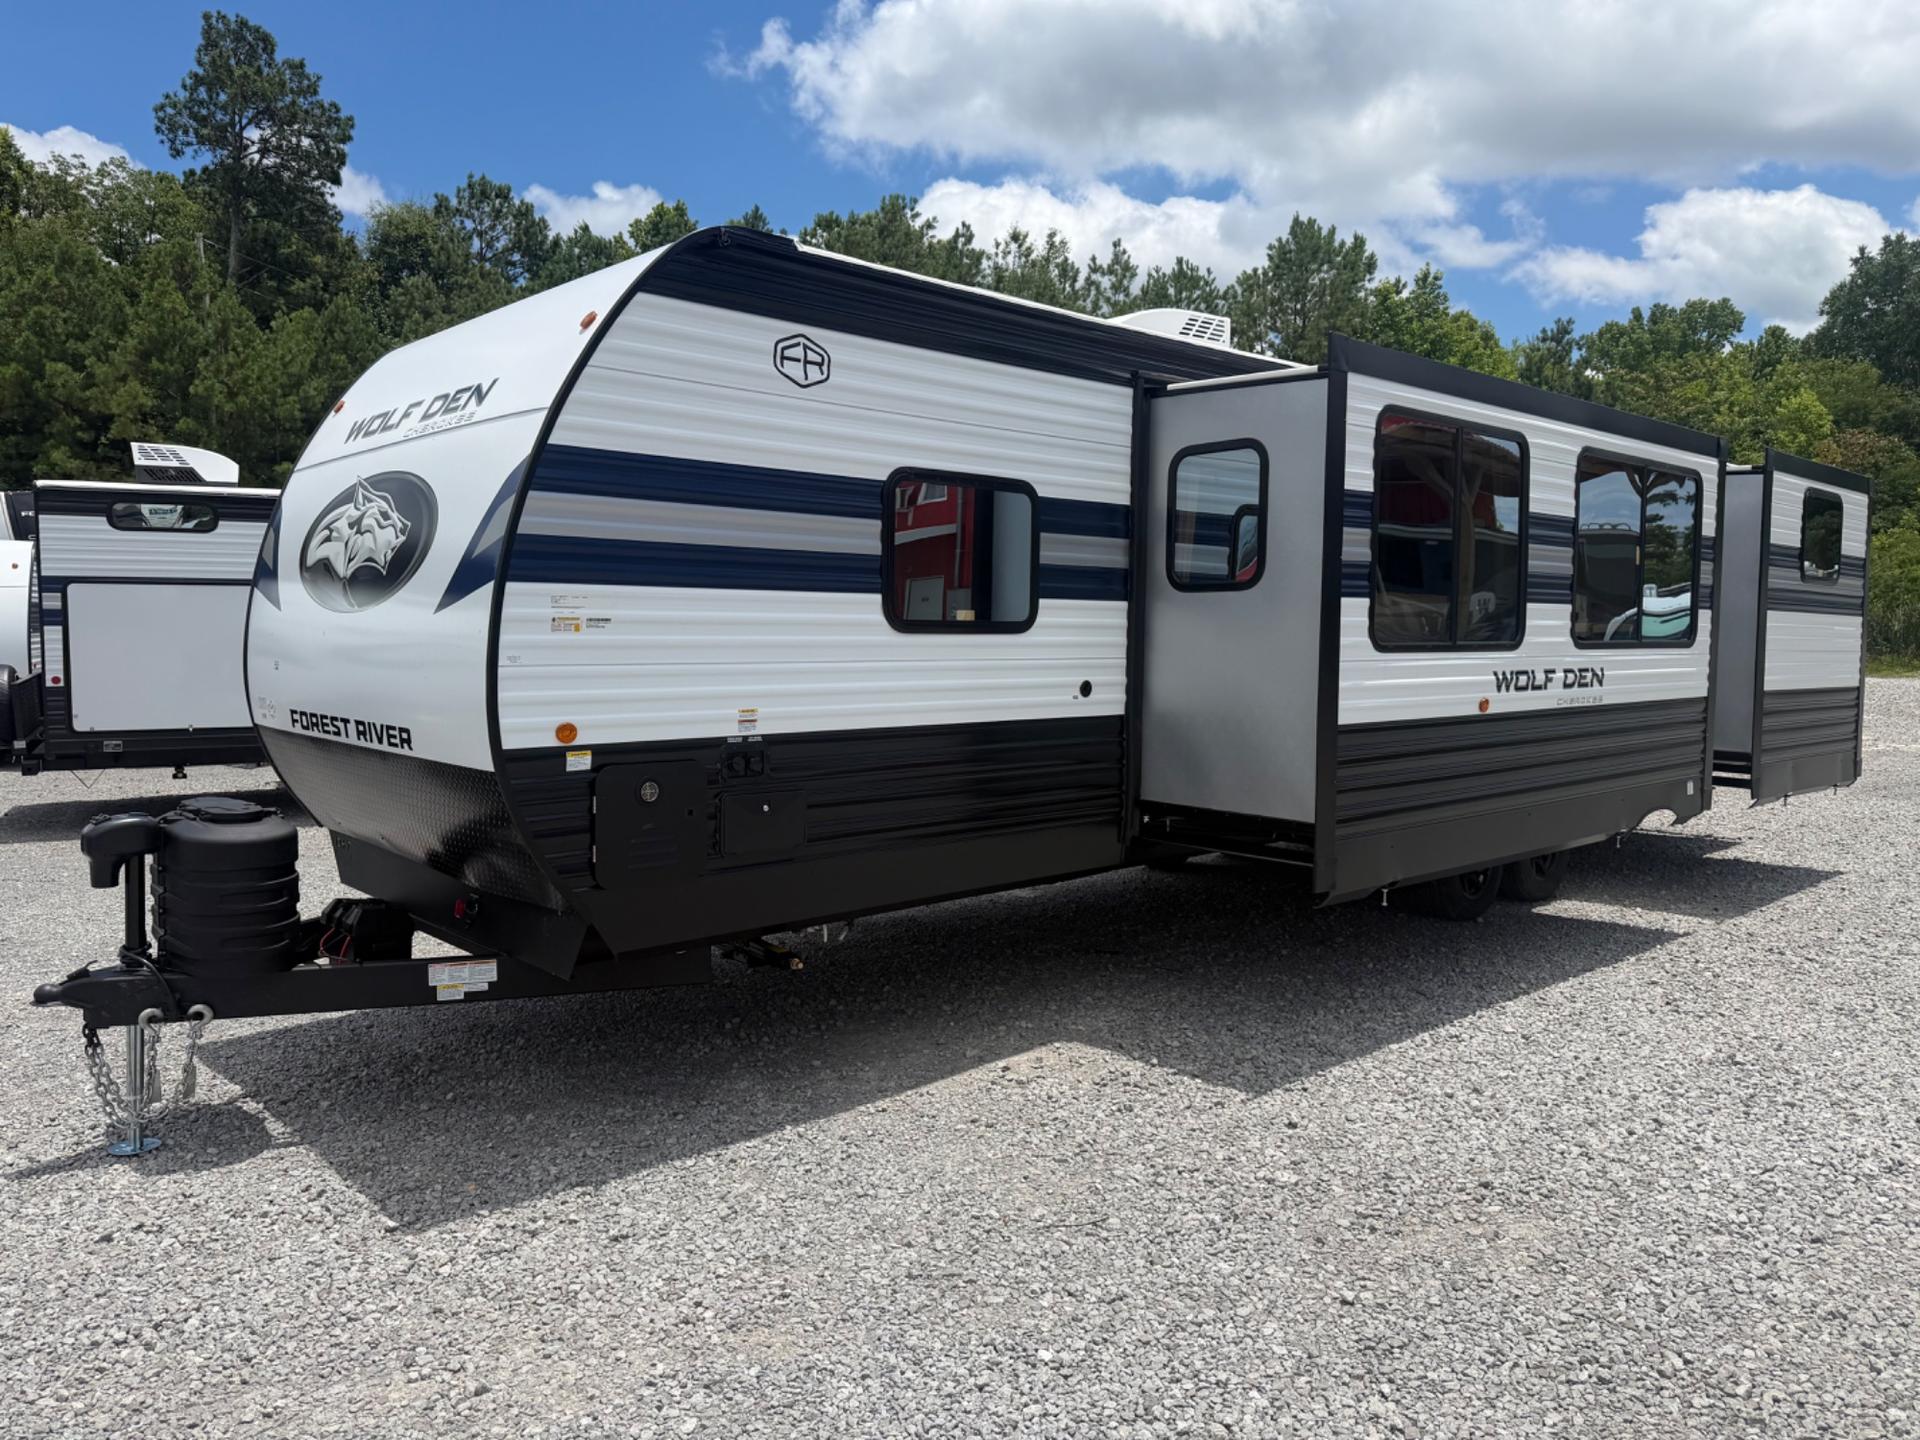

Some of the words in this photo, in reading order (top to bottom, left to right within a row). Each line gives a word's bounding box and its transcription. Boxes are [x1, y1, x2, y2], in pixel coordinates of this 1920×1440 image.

[344, 399, 425, 444] WOLF
[418, 377, 499, 423] DEN
[1493, 668, 1556, 693] WOLF
[1562, 667, 1605, 689] DEN
[289, 708, 351, 739] FOREST
[354, 719, 413, 751] RIVER
